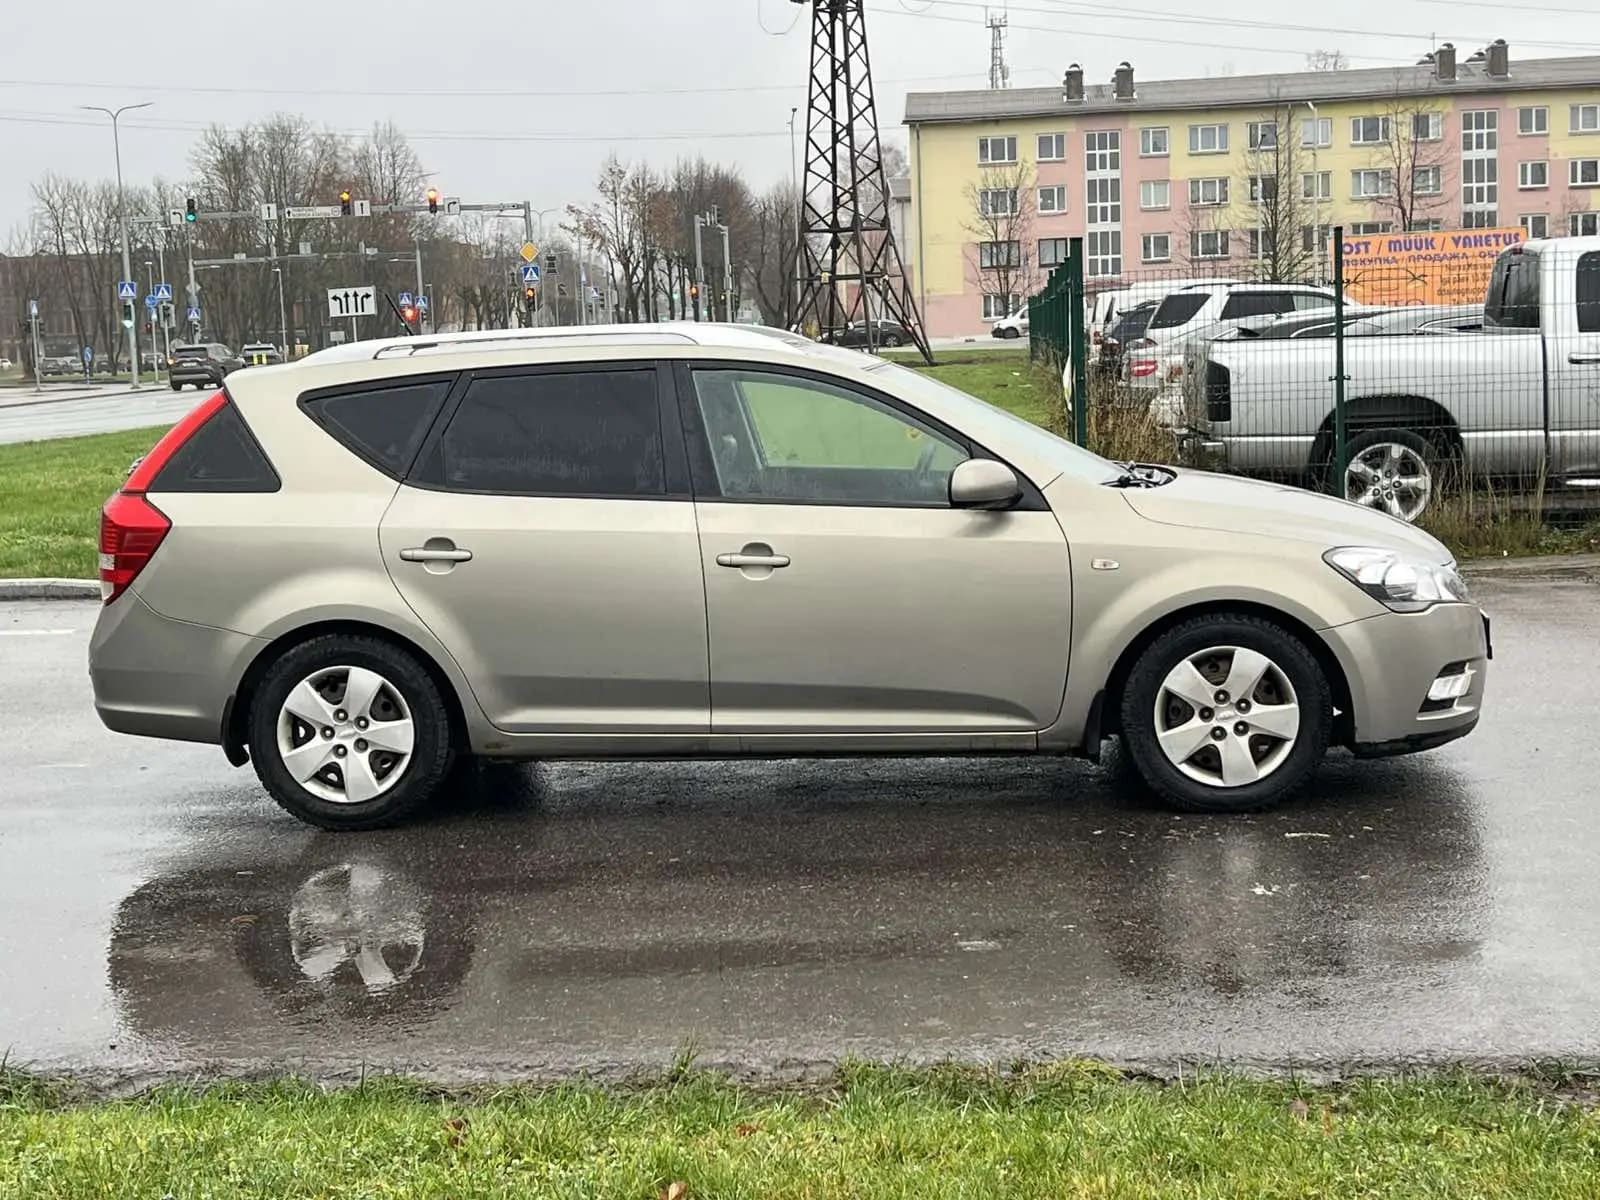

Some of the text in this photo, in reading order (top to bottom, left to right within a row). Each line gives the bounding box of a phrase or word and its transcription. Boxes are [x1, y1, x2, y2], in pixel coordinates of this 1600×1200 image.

[1343, 241, 1371, 255] OST
[1388, 236, 1435, 252] MÜÜK
[1451, 232, 1520, 249] VAHETUS
[1408, 252, 1469, 263] ПРОДАЖА
